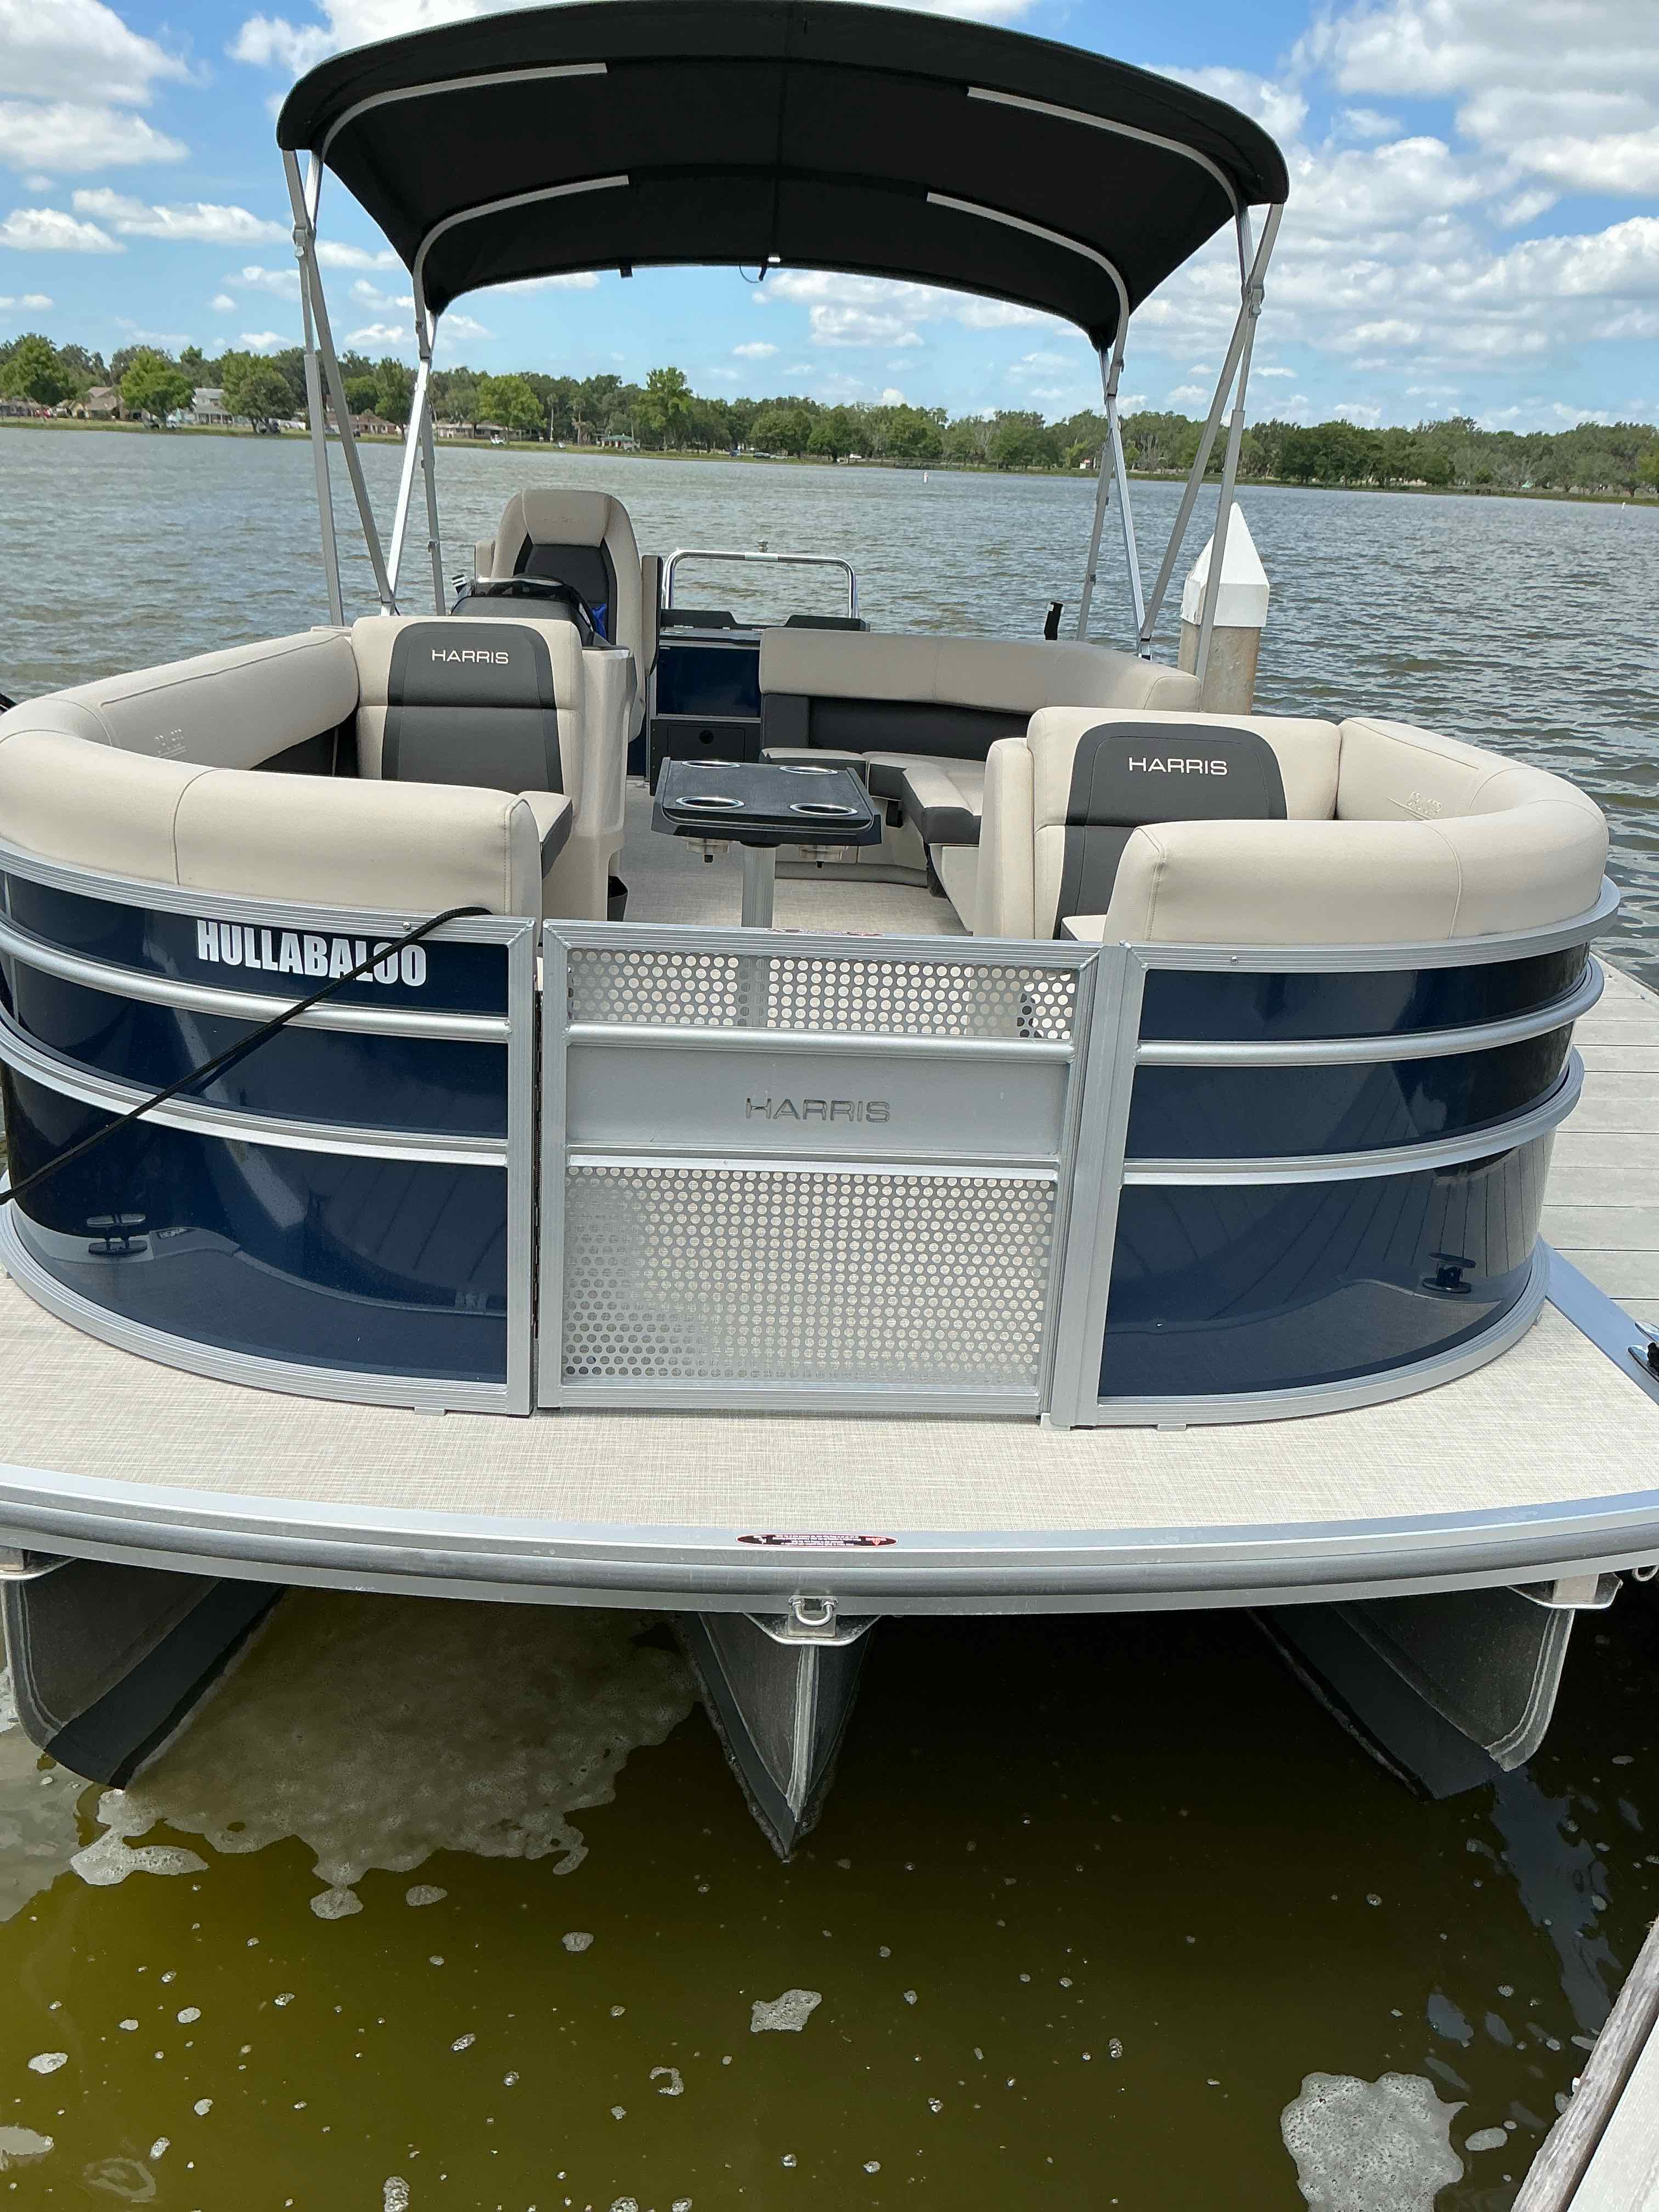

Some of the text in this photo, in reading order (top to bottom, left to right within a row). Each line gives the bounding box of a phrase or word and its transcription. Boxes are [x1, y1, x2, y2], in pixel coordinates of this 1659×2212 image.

[432, 649, 509, 664] HARRIS
[1128, 757, 1228, 776] HARRIS
[197, 919, 426, 986] HULLABALOO
[746, 1098, 890, 1122] HARRIS
